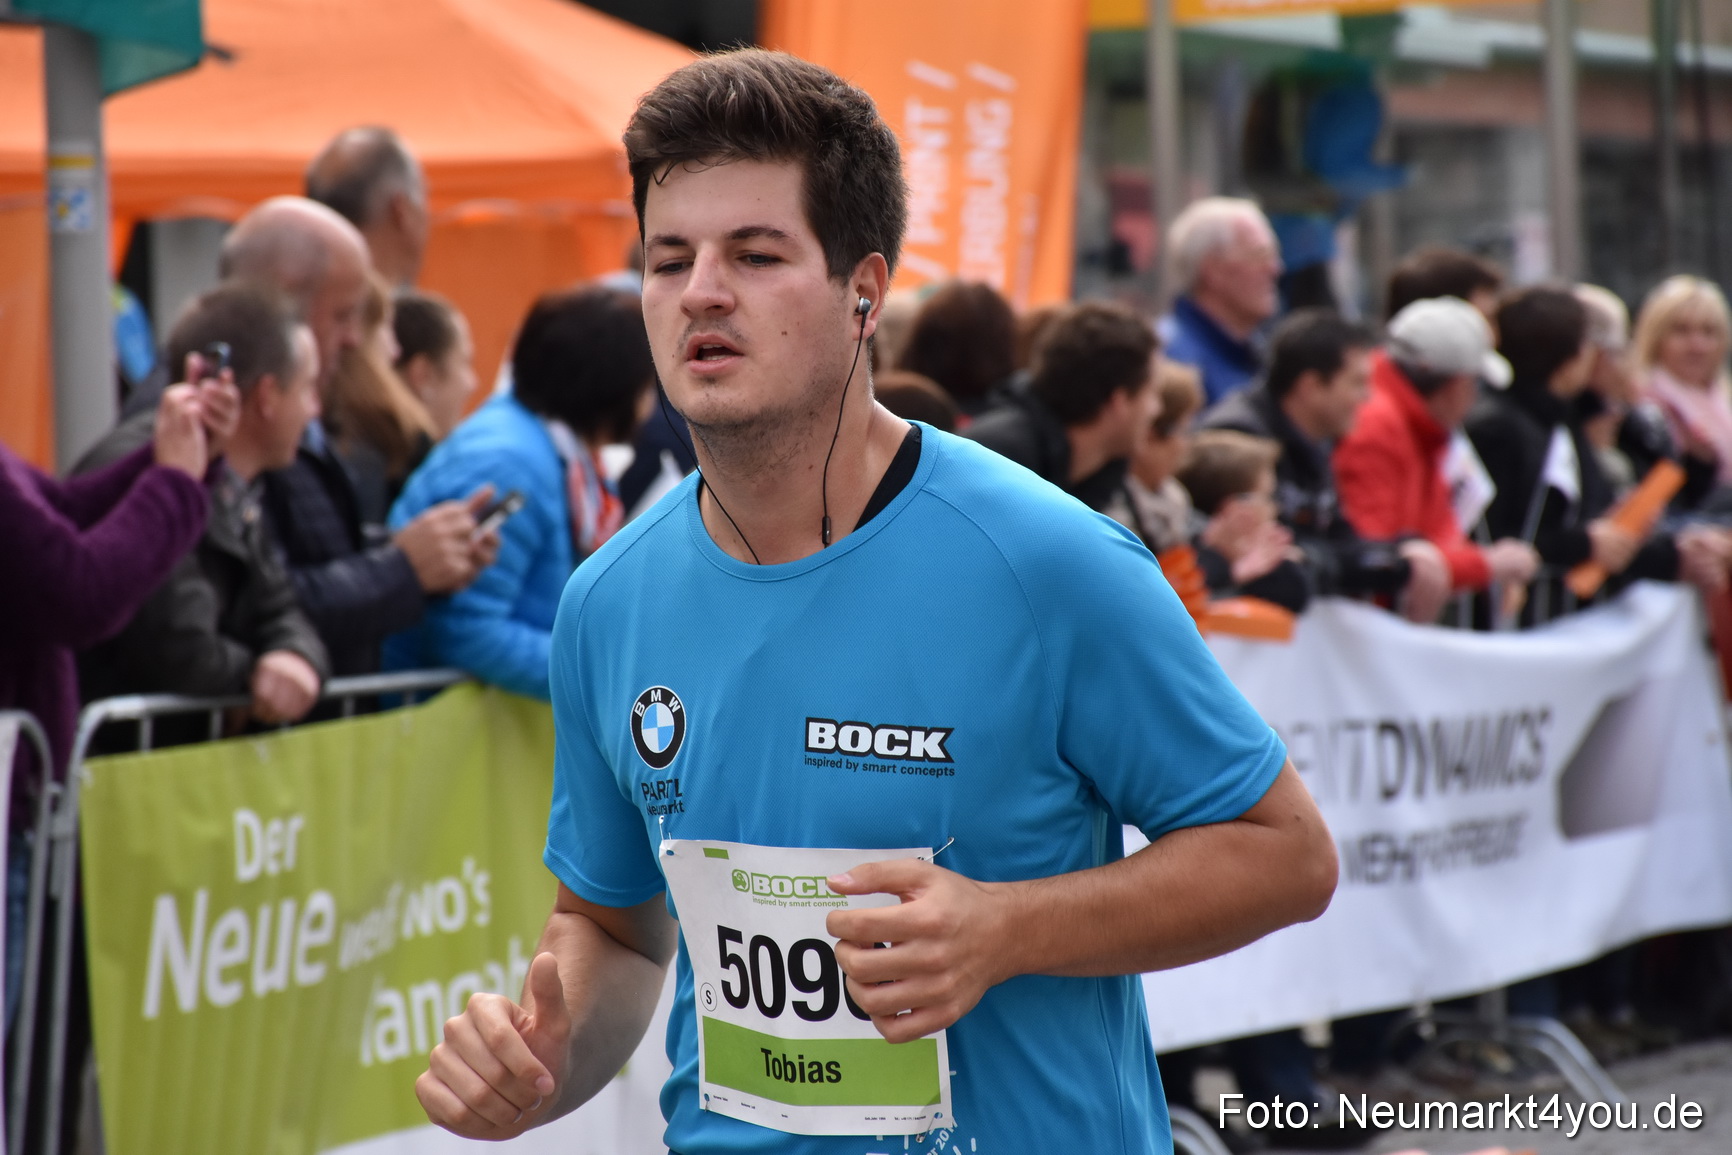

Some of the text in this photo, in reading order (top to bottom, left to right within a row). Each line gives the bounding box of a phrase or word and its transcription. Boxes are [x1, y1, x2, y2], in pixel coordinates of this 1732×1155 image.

[634, 689, 681, 717] BMW
[806, 718, 953, 761] BOCK
[804, 755, 955, 778] inspired by smart concepts
[233, 808, 305, 883] Der
[752, 896, 849, 908] inspired by smart concepts
[143, 889, 335, 1019] Neue
[717, 924, 895, 1022] 509
[760, 1047, 842, 1085] Tobias
